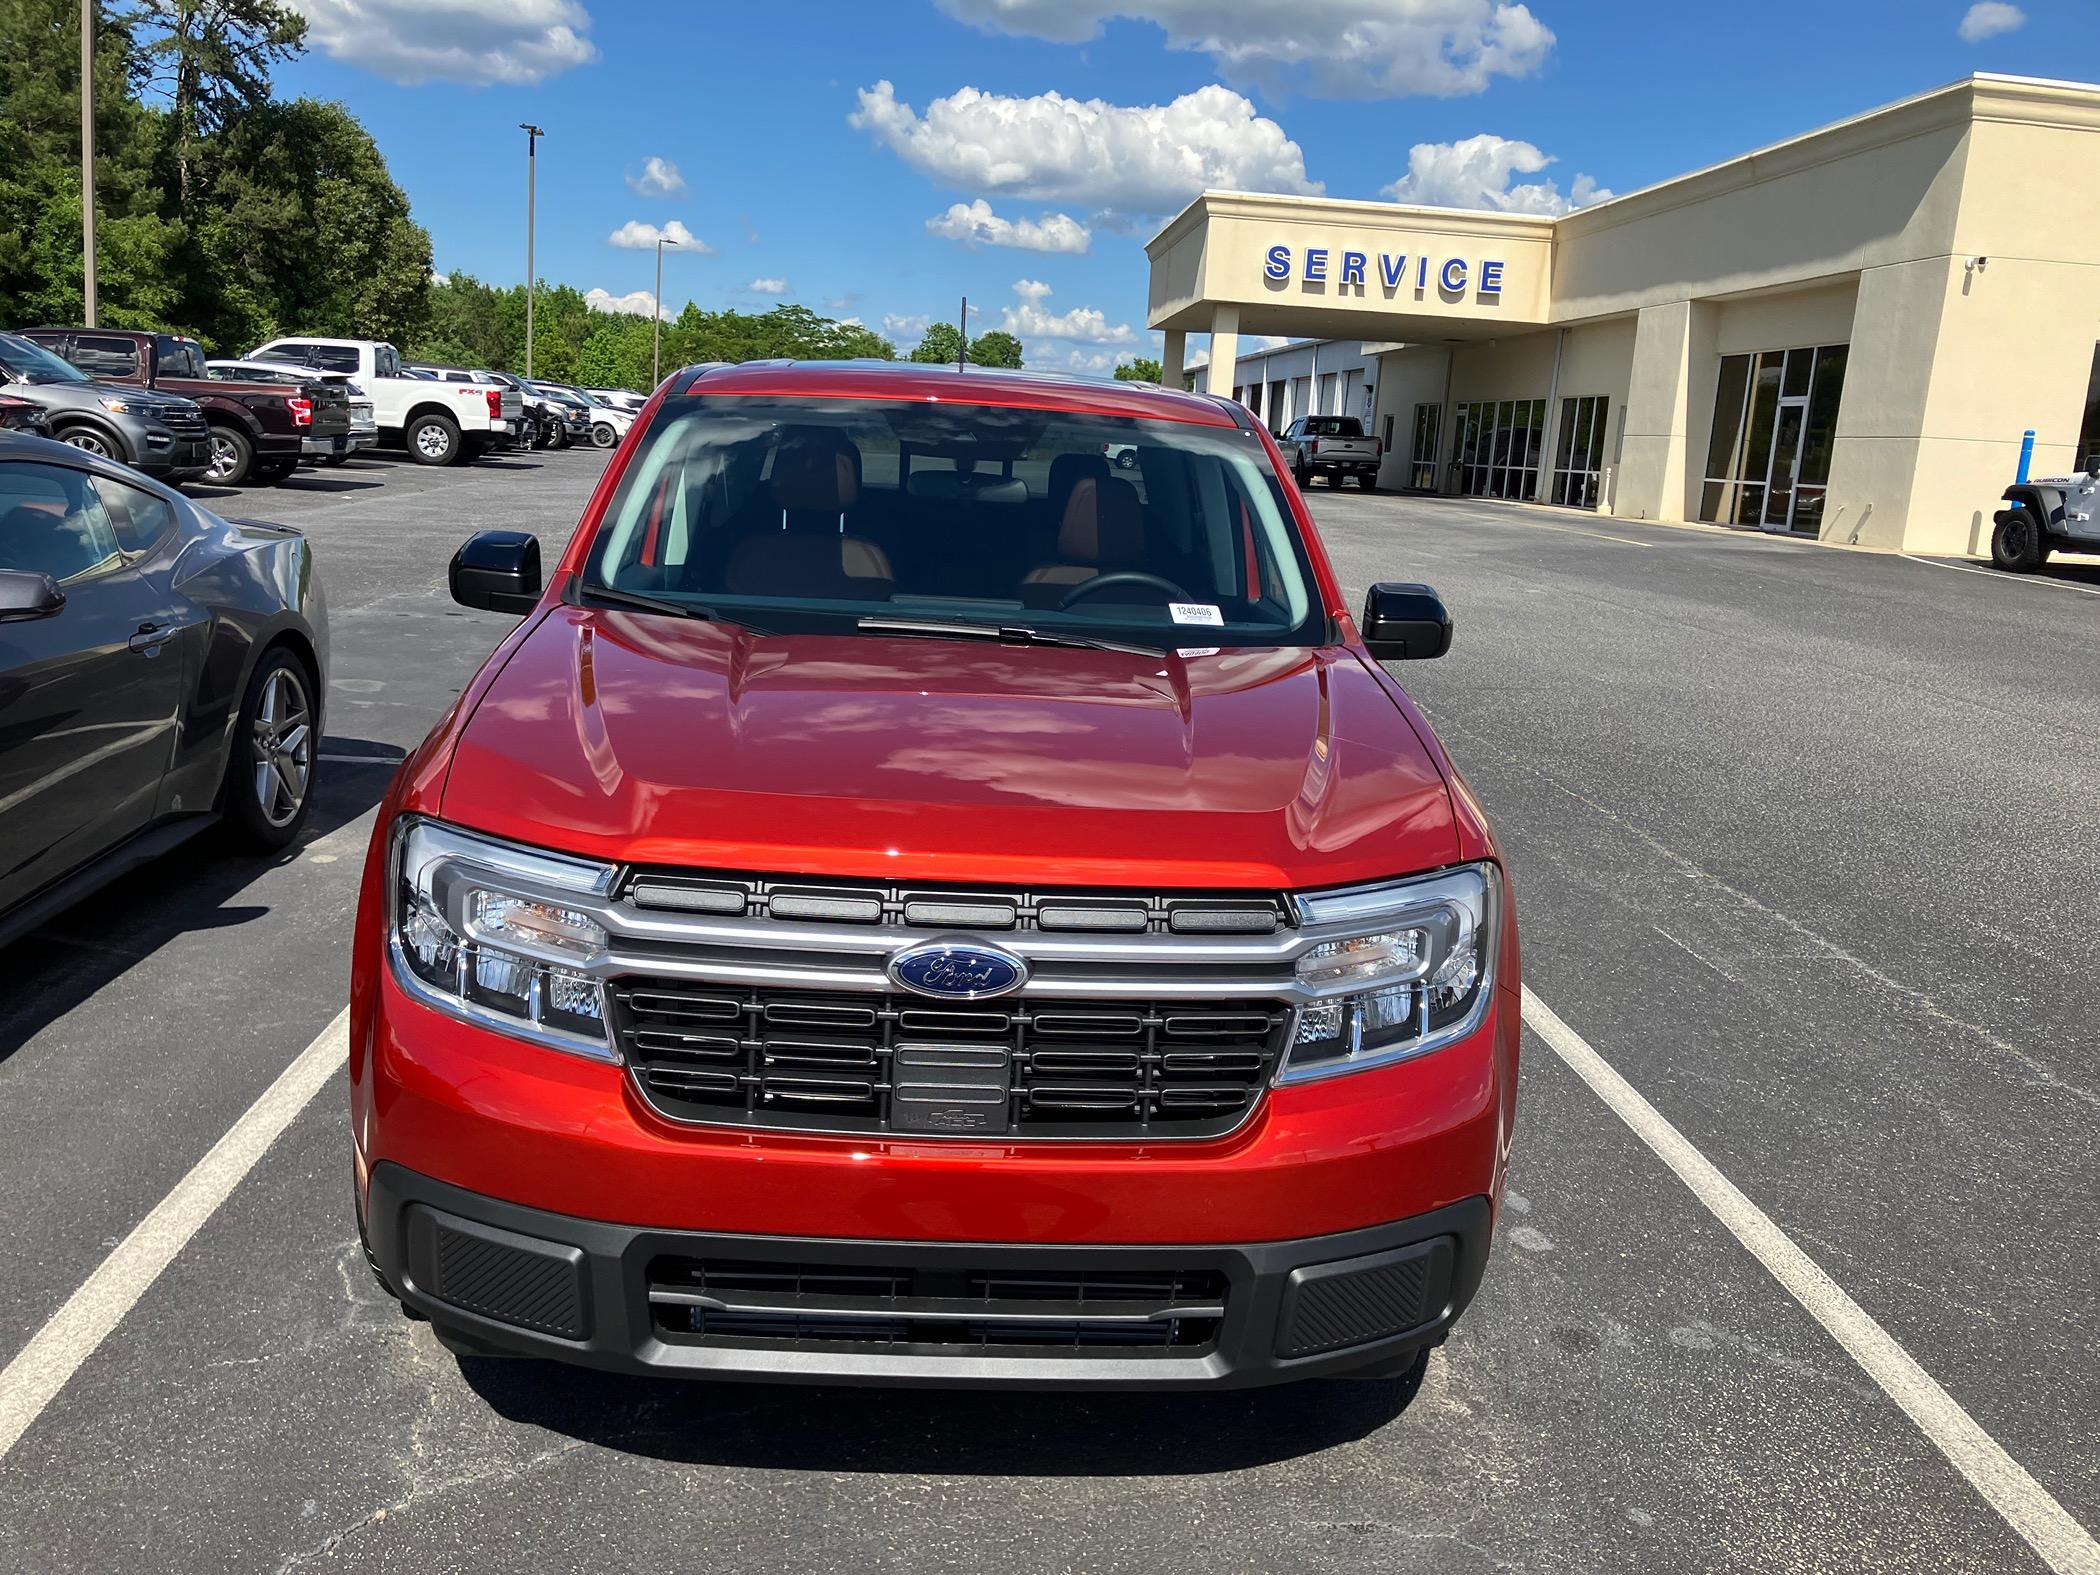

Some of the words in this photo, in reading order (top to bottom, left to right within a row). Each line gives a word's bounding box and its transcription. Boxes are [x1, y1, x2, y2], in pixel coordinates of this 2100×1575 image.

[1264, 244, 1505, 293] SERVICE
[1177, 607, 1212, 616] 1240406
[923, 957, 993, 987] Ford
